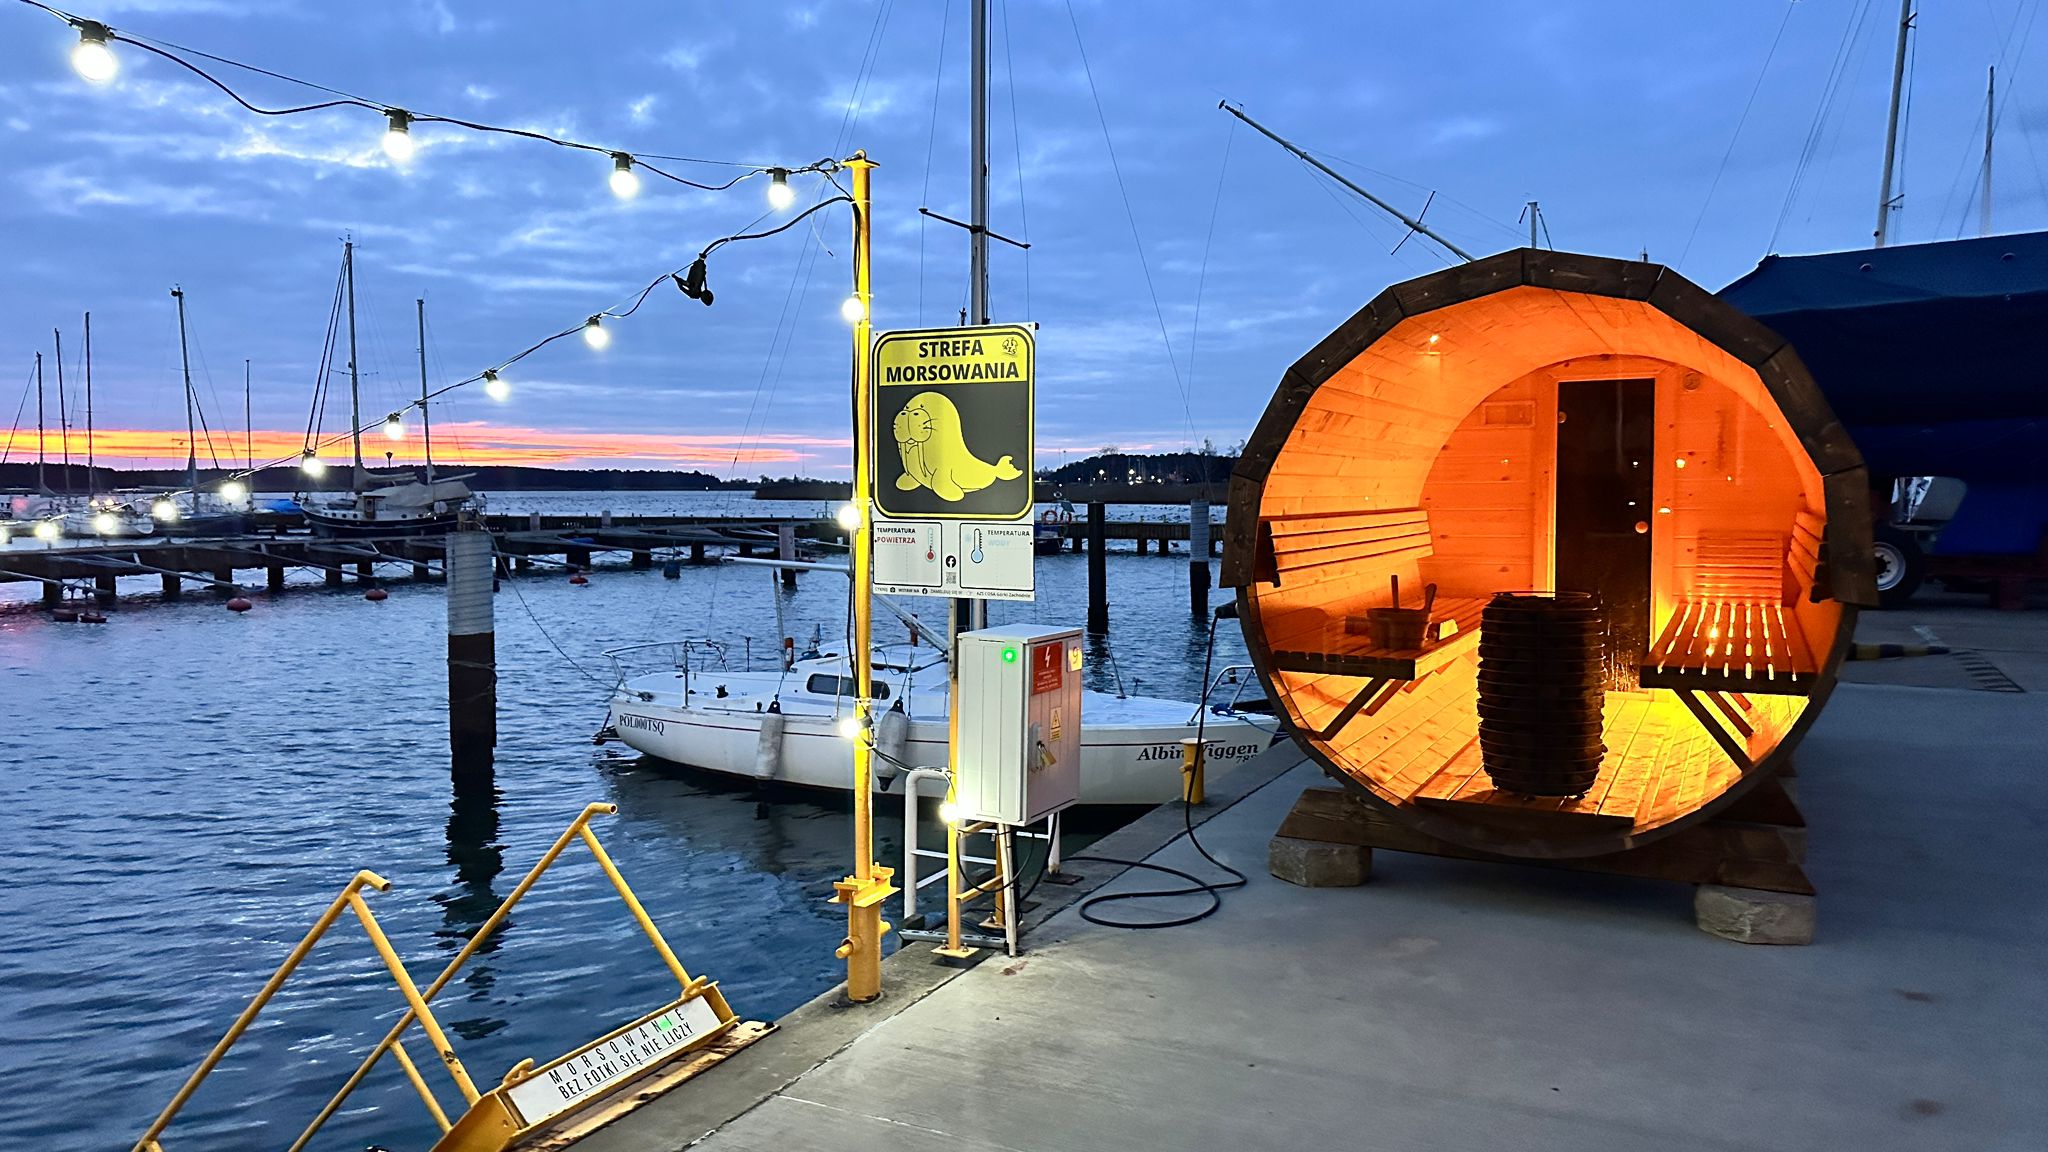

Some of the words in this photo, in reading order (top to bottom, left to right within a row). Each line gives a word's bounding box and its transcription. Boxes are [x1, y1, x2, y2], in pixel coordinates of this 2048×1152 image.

[918, 339, 984, 358] STREFA
[886, 362, 1020, 383] MORSOWANIA
[877, 536, 916, 544] POWIETRZA
[1136, 745, 1184, 761] Albin
[549, 1008, 685, 1085] MORSOWANIE
[558, 1078, 584, 1099] BEZ
[585, 1060, 619, 1086] FOTKI
[620, 1049, 643, 1067] SIĘ
[640, 1038, 662, 1056] NIE
[662, 1022, 693, 1045] LICZY
